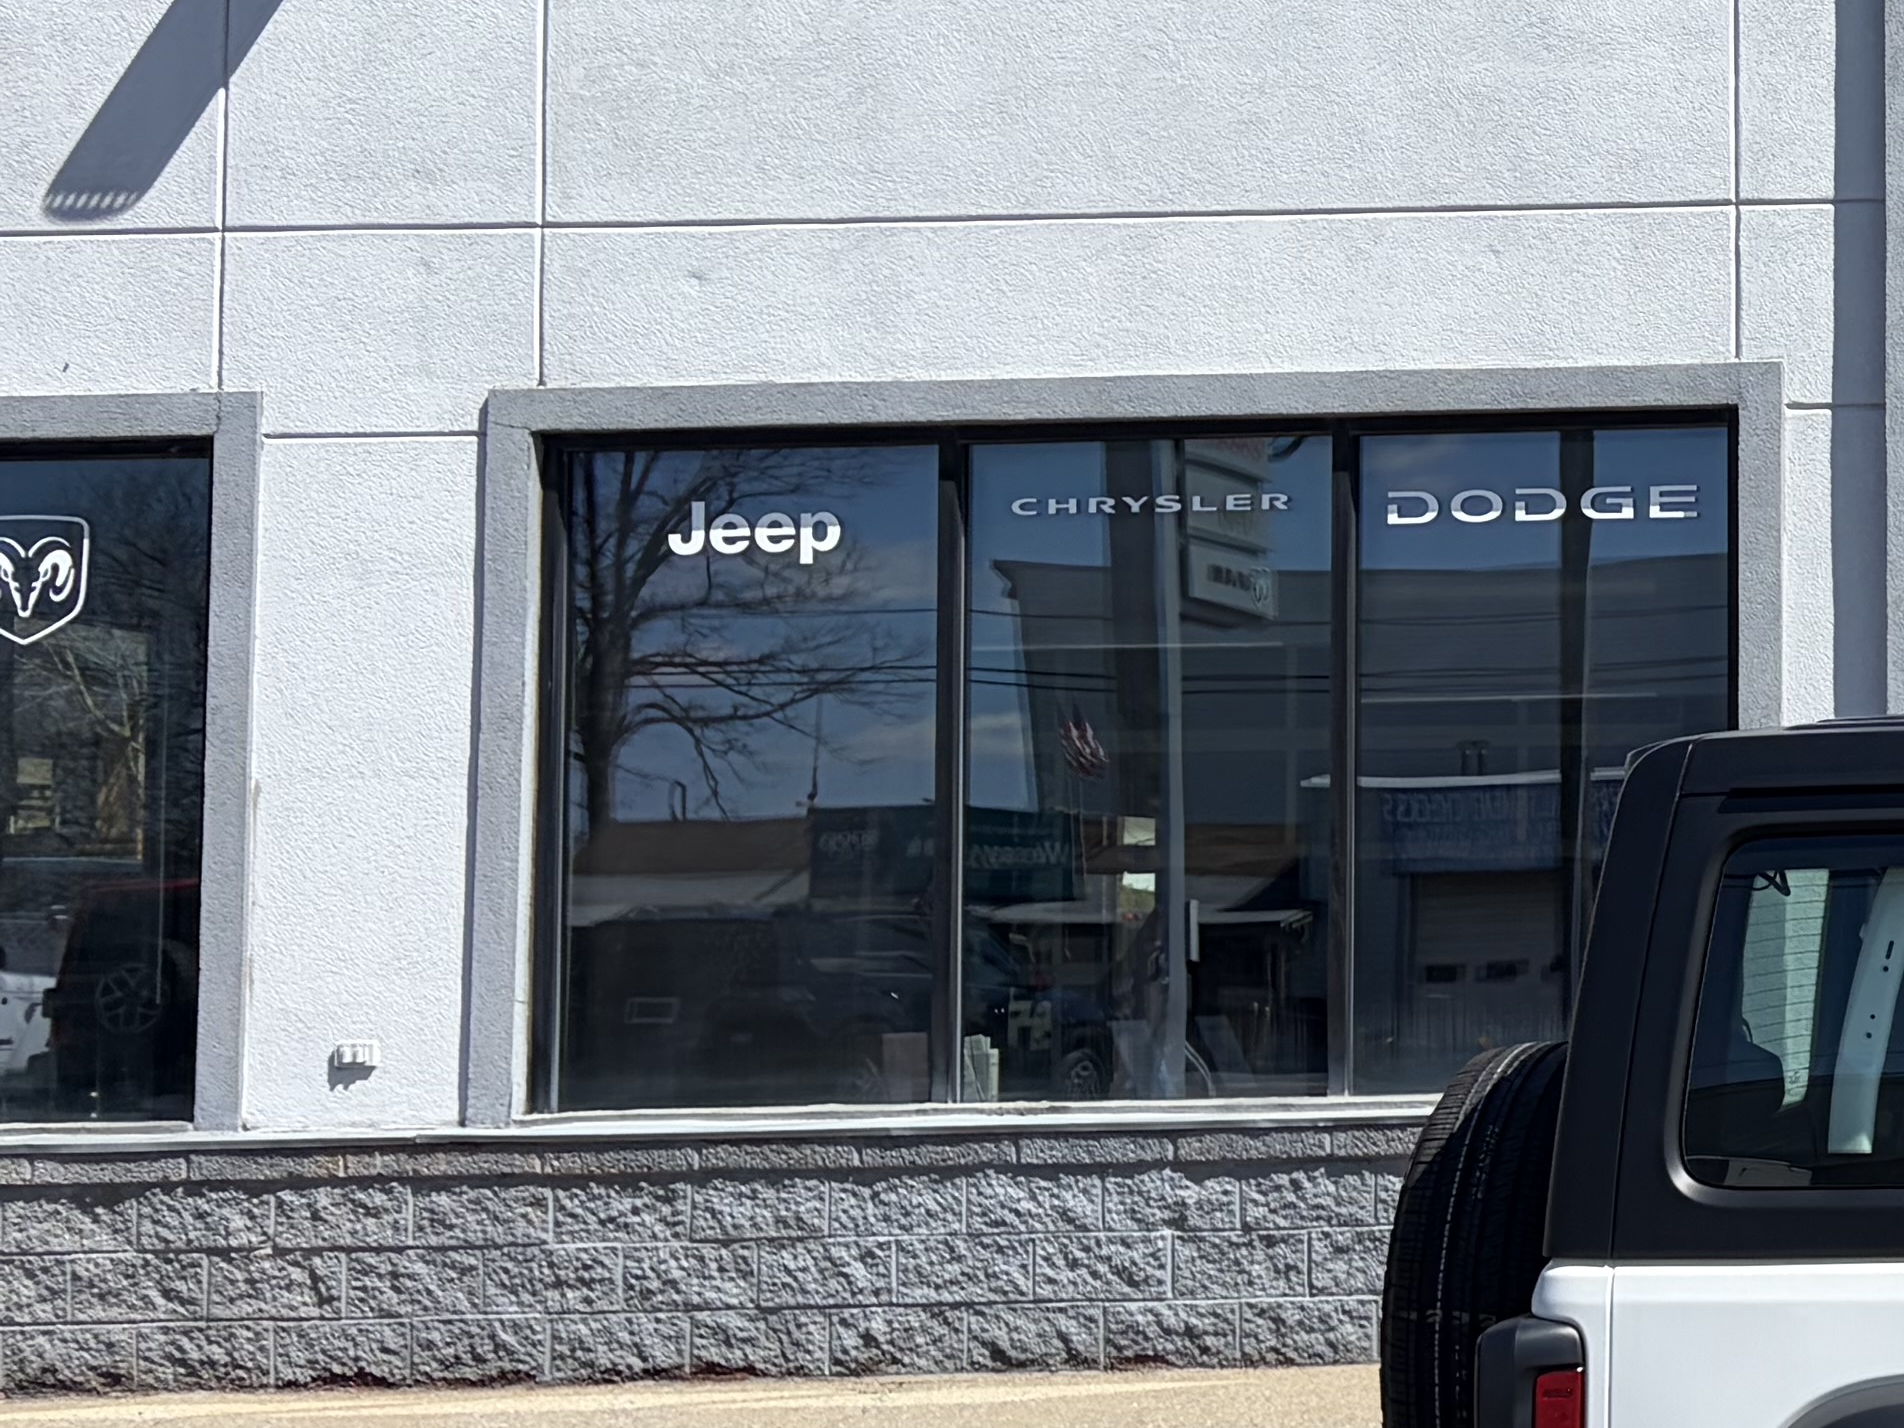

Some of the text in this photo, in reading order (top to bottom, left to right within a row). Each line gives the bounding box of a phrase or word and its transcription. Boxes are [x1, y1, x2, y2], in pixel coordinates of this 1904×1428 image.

[1011, 493, 1290, 516] CHRYSLER
[1387, 485, 1700, 525] DODGE
[668, 501, 842, 565] Jeep
